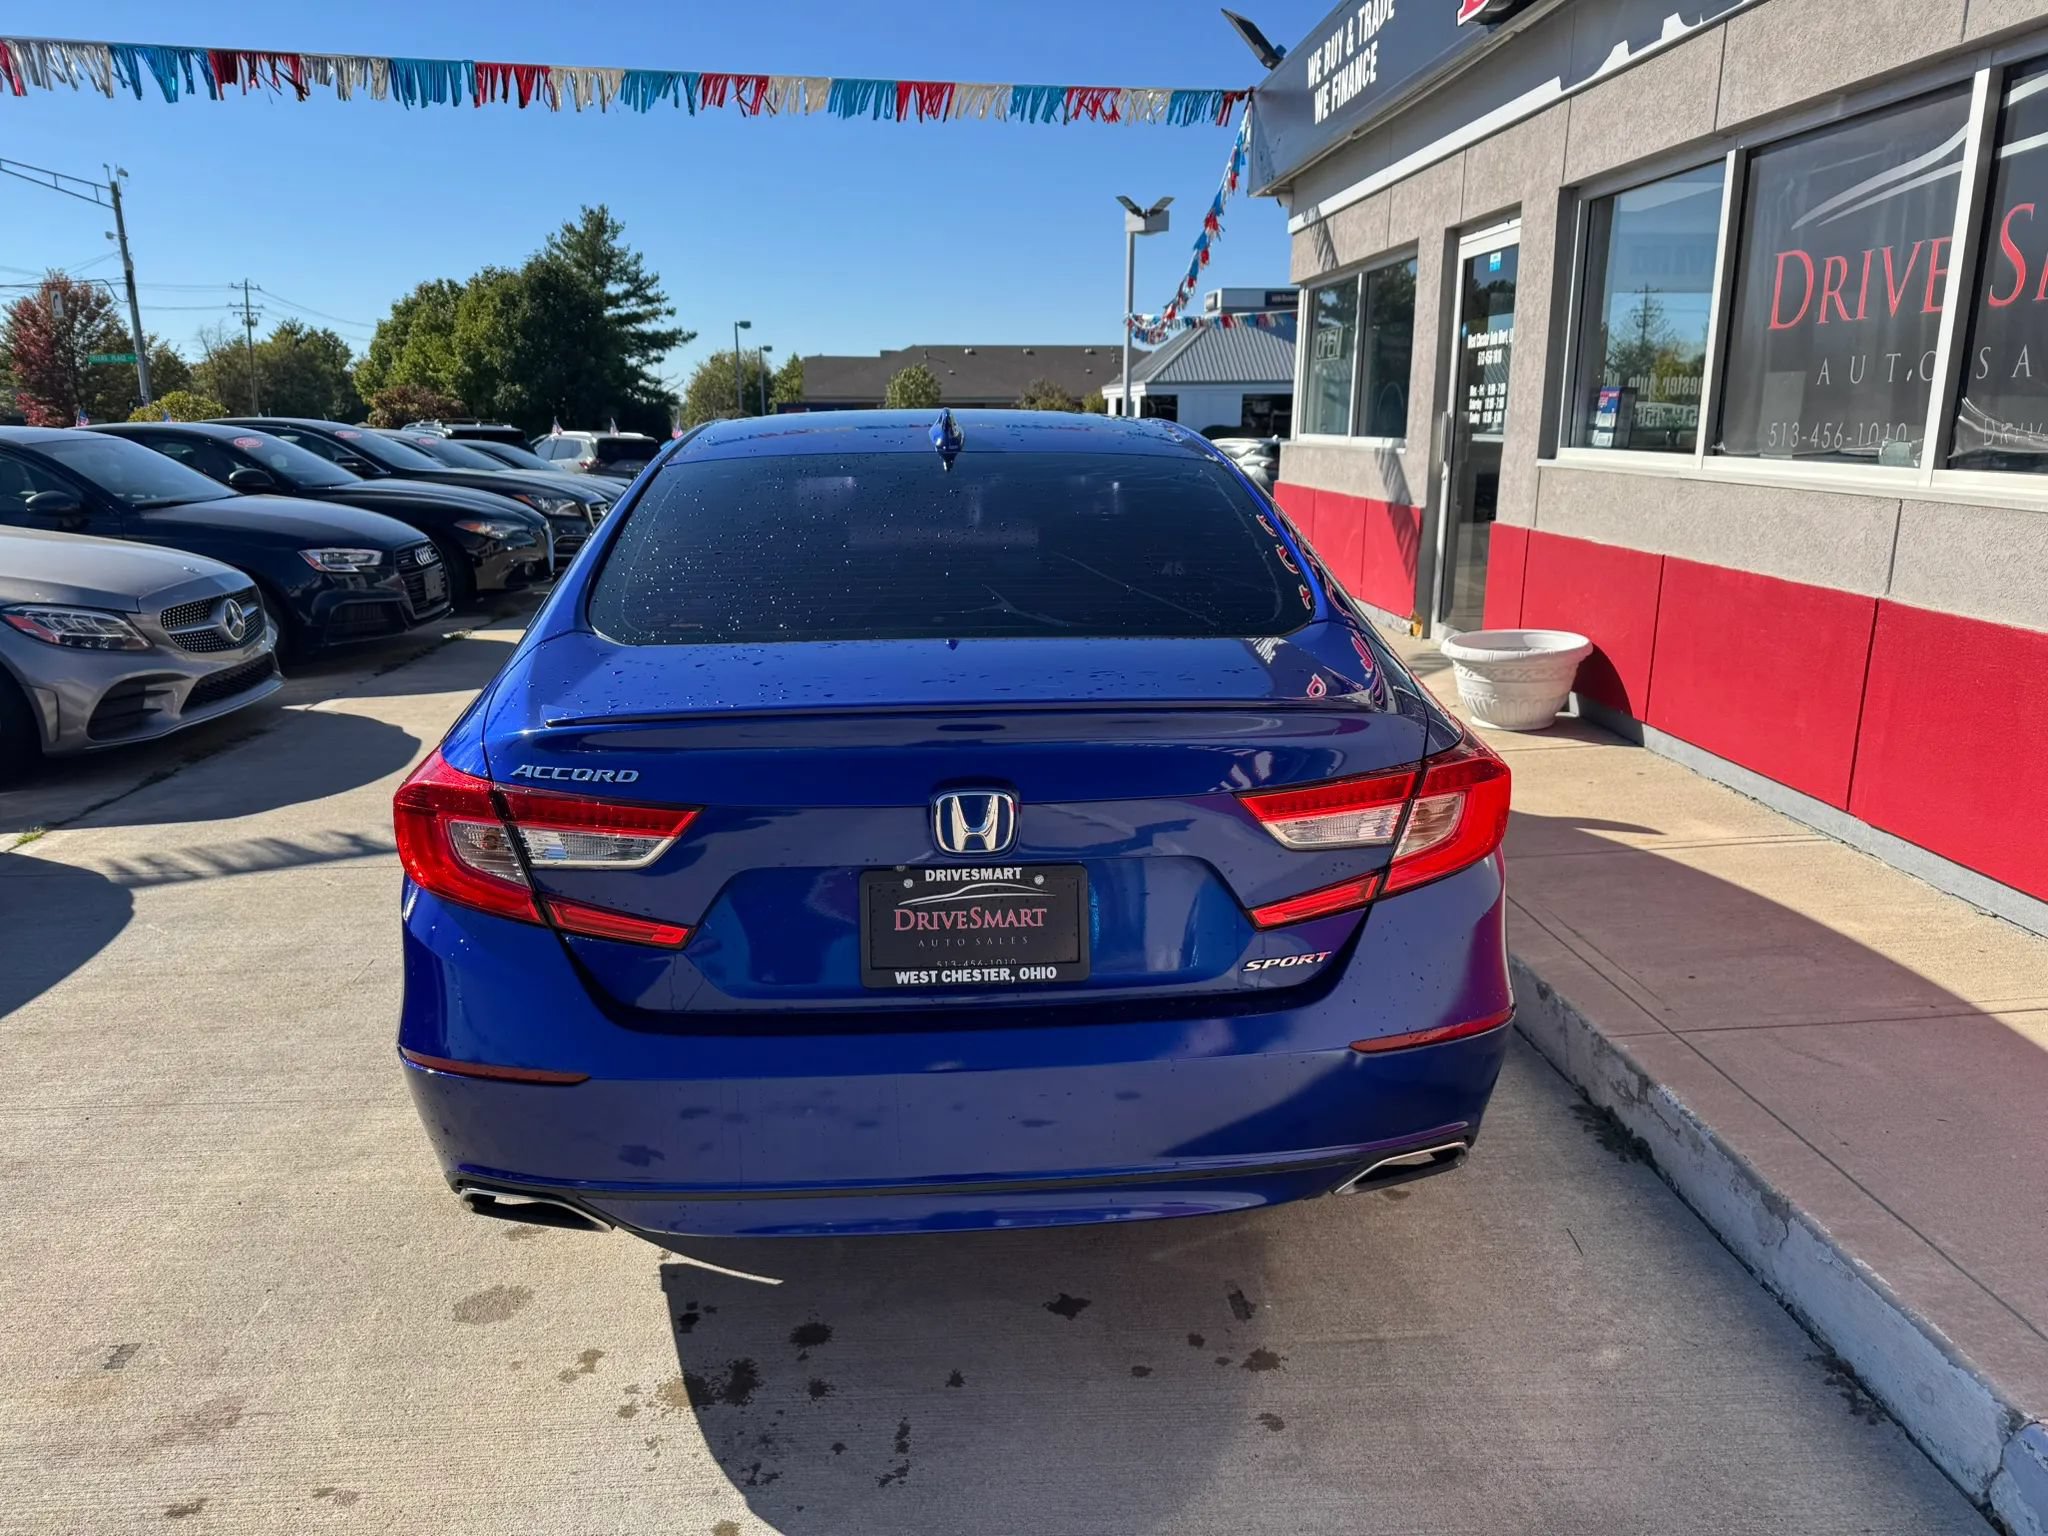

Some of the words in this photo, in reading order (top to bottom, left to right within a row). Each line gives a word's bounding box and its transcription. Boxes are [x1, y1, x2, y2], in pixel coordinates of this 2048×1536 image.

[1307, 47, 1322, 89] WE
[1323, 25, 1344, 76] BUY
[1346, 16, 1354, 57] &
[1358, 0, 1395, 46] TRADE
[1314, 81, 1330, 125] WE
[1331, 40, 1378, 113] FINANCE
[510, 764, 639, 783] ACCORD
[925, 867, 1022, 882] DRIVESMART
[918, 938, 966, 948] AUTO
[975, 936, 1028, 946] SALES
[1242, 951, 1332, 972] SPORT
[895, 970, 938, 985] WEST
[941, 967, 1016, 983] CHESTER,
[1019, 966, 1057, 980] OHIO
